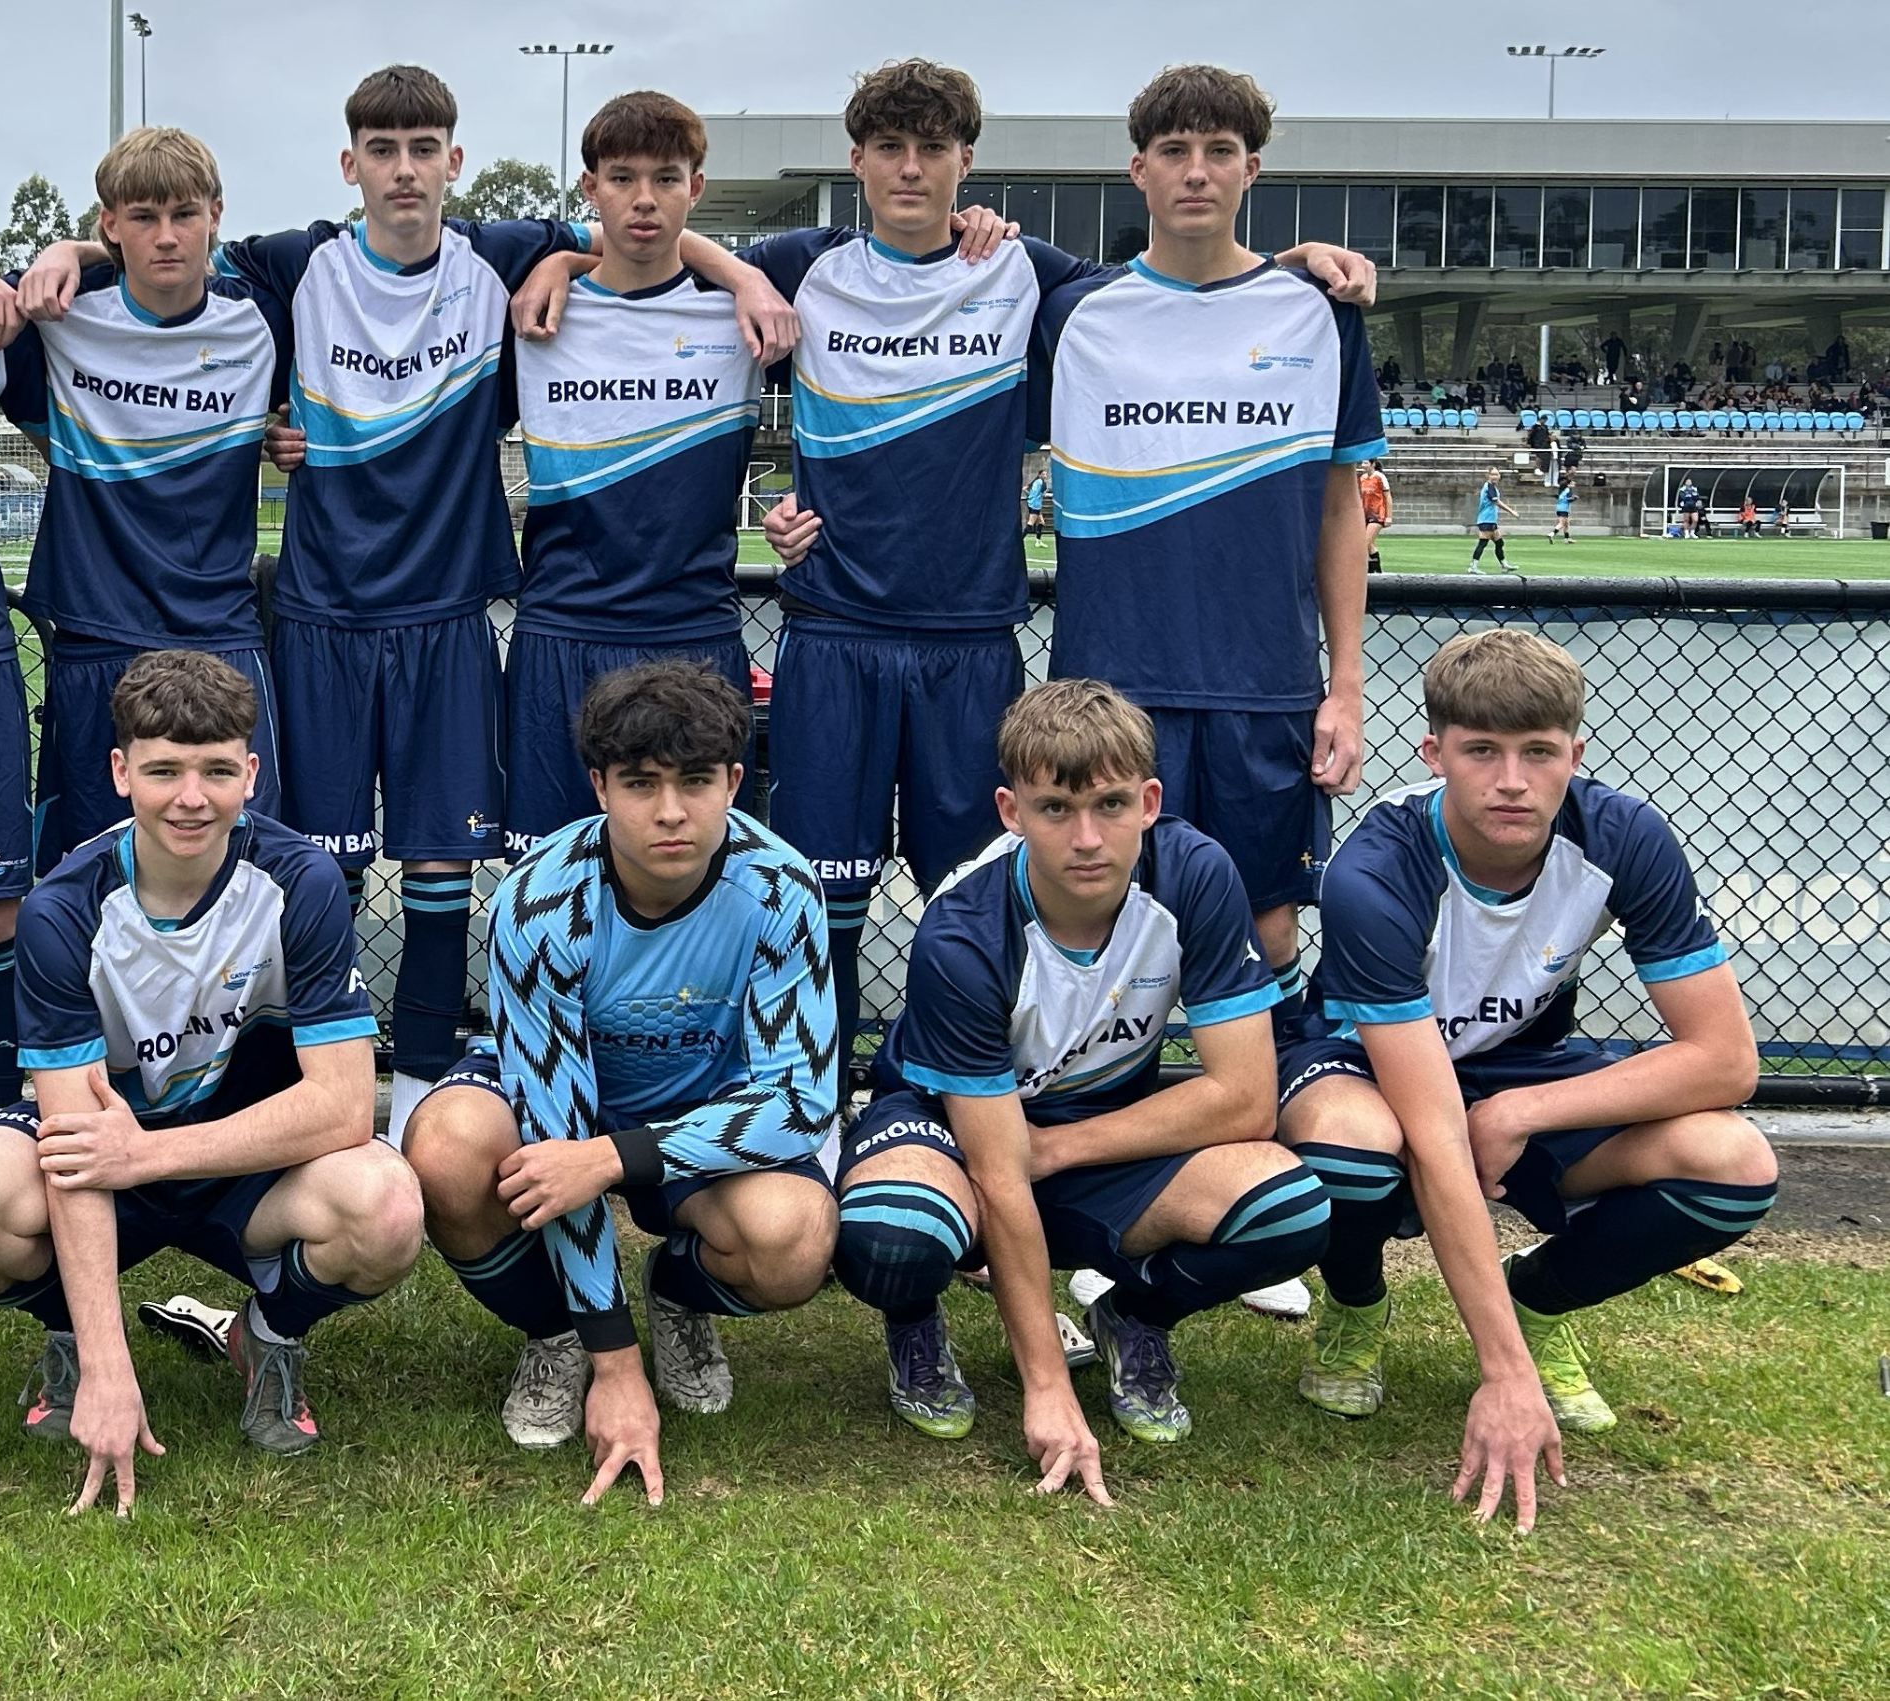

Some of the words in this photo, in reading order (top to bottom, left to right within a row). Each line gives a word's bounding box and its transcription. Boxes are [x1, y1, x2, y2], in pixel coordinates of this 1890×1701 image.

[330, 344, 422, 381] BROKEN
[429, 330, 470, 368] BAY
[827, 331, 940, 358] BROKEN
[949, 333, 1003, 357] BAY
[73, 368, 177, 408] BROKEN
[185, 389, 236, 414] BAY
[547, 378, 657, 402] BROKEN
[665, 378, 720, 401] BAY
[1104, 401, 1226, 428] BROKEN
[1236, 402, 1296, 428] BAY
[856, 1121, 956, 1155] BROKEN
